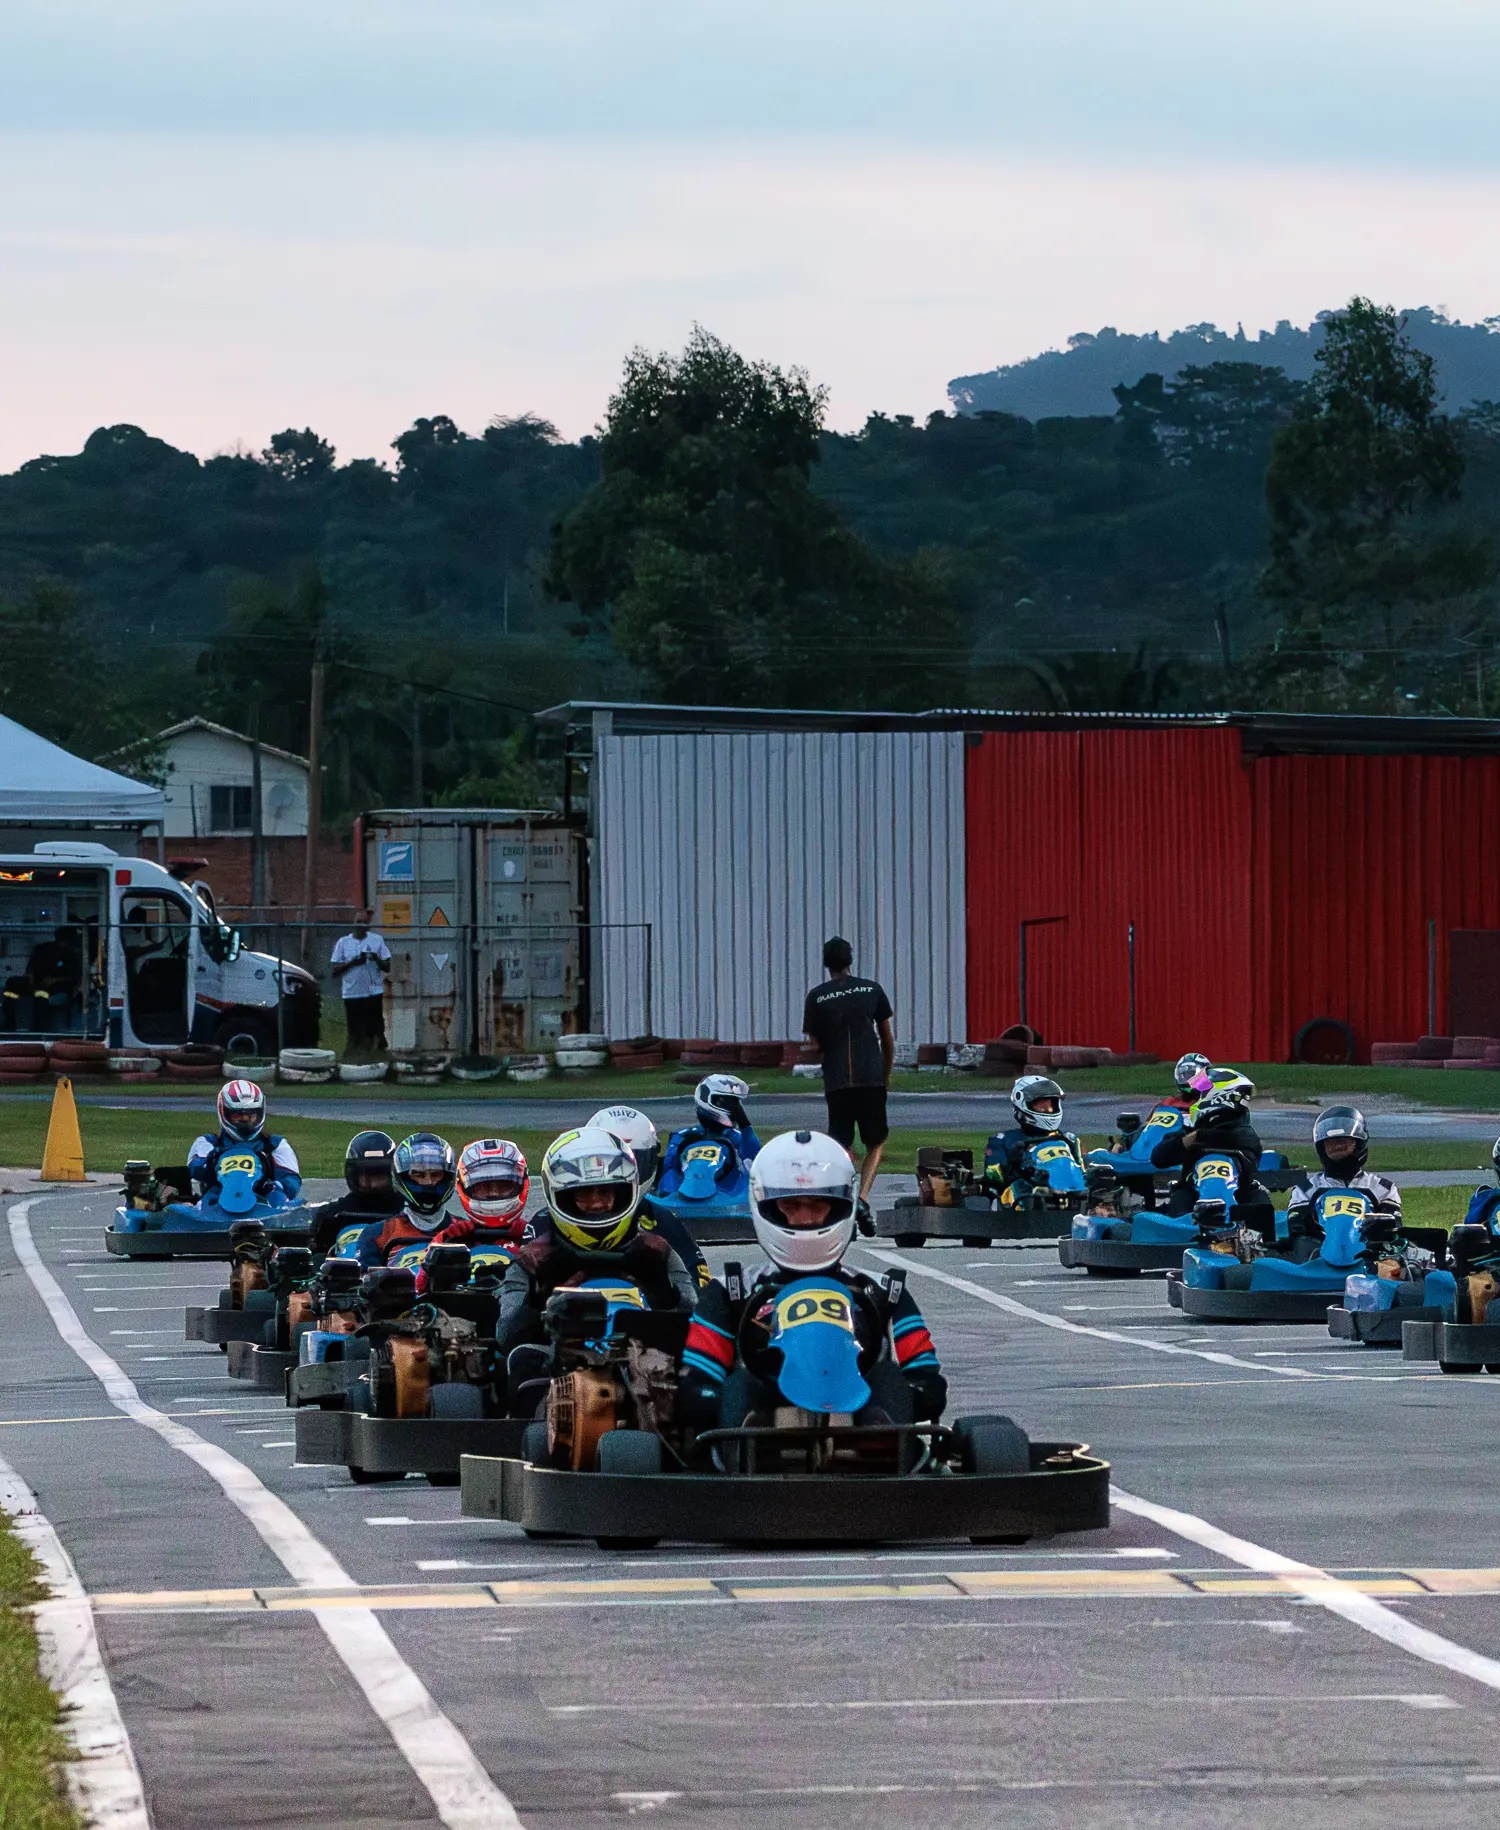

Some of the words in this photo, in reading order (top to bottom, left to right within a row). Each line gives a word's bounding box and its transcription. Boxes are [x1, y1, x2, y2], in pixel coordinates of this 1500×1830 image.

[224, 1158, 253, 1172] 20
[1201, 1164, 1231, 1178] 26
[1330, 1199, 1363, 1215] 15
[786, 1297, 850, 1323] 09
